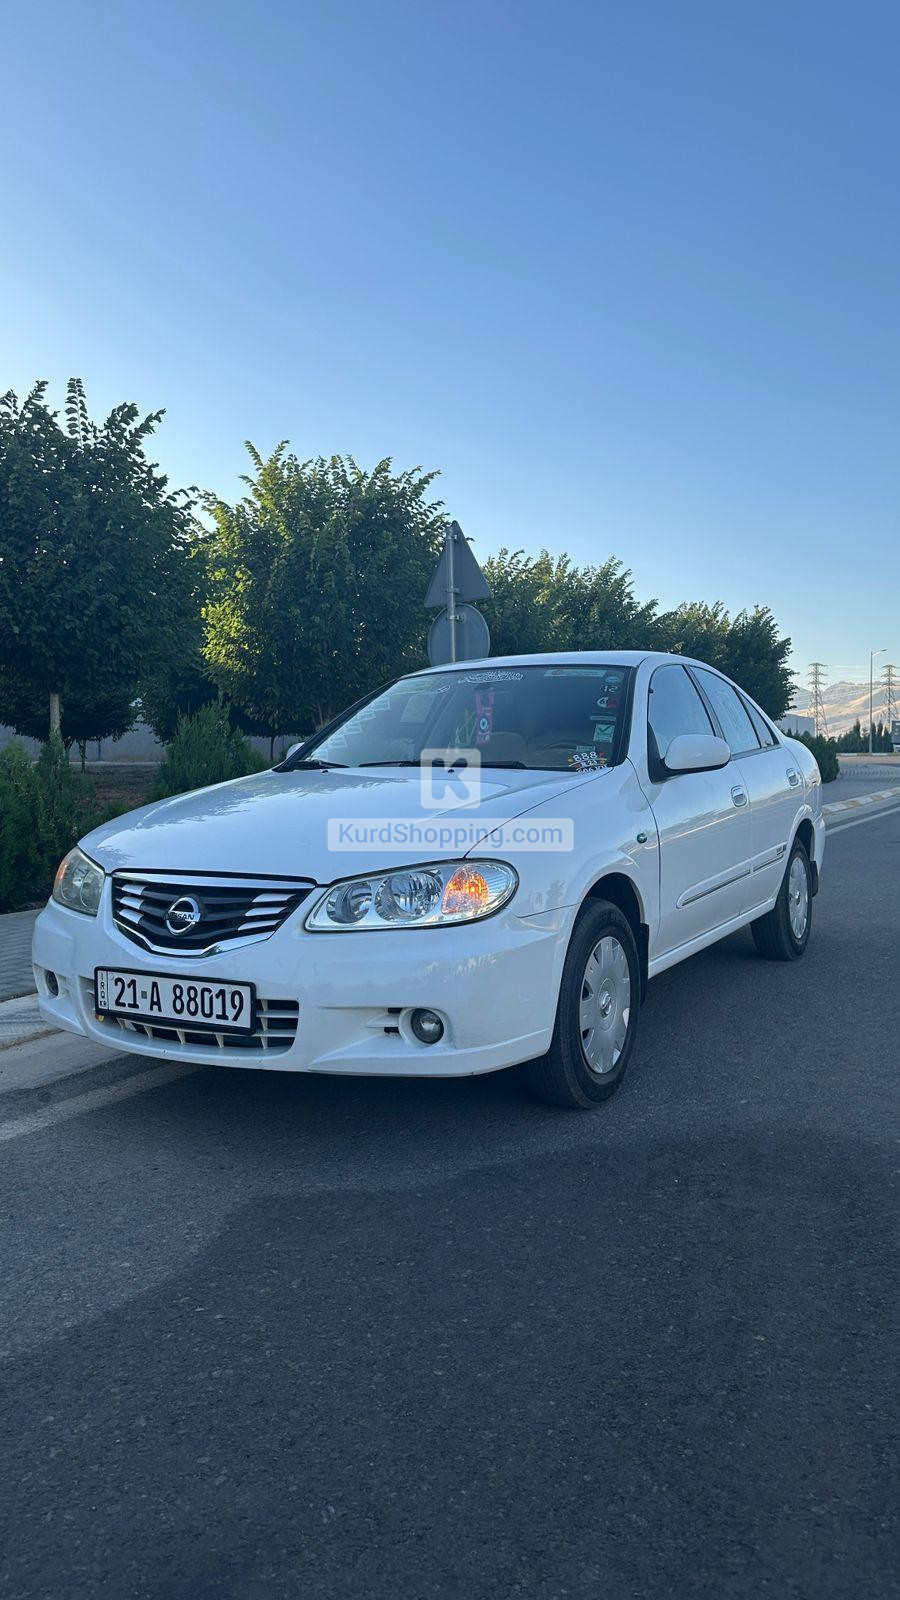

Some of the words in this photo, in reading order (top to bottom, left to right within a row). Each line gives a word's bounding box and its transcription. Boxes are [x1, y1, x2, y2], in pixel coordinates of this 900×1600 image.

[114, 977, 140, 1009] 21
[149, 981, 162, 1012] A
[172, 984, 244, 1022] 88019
